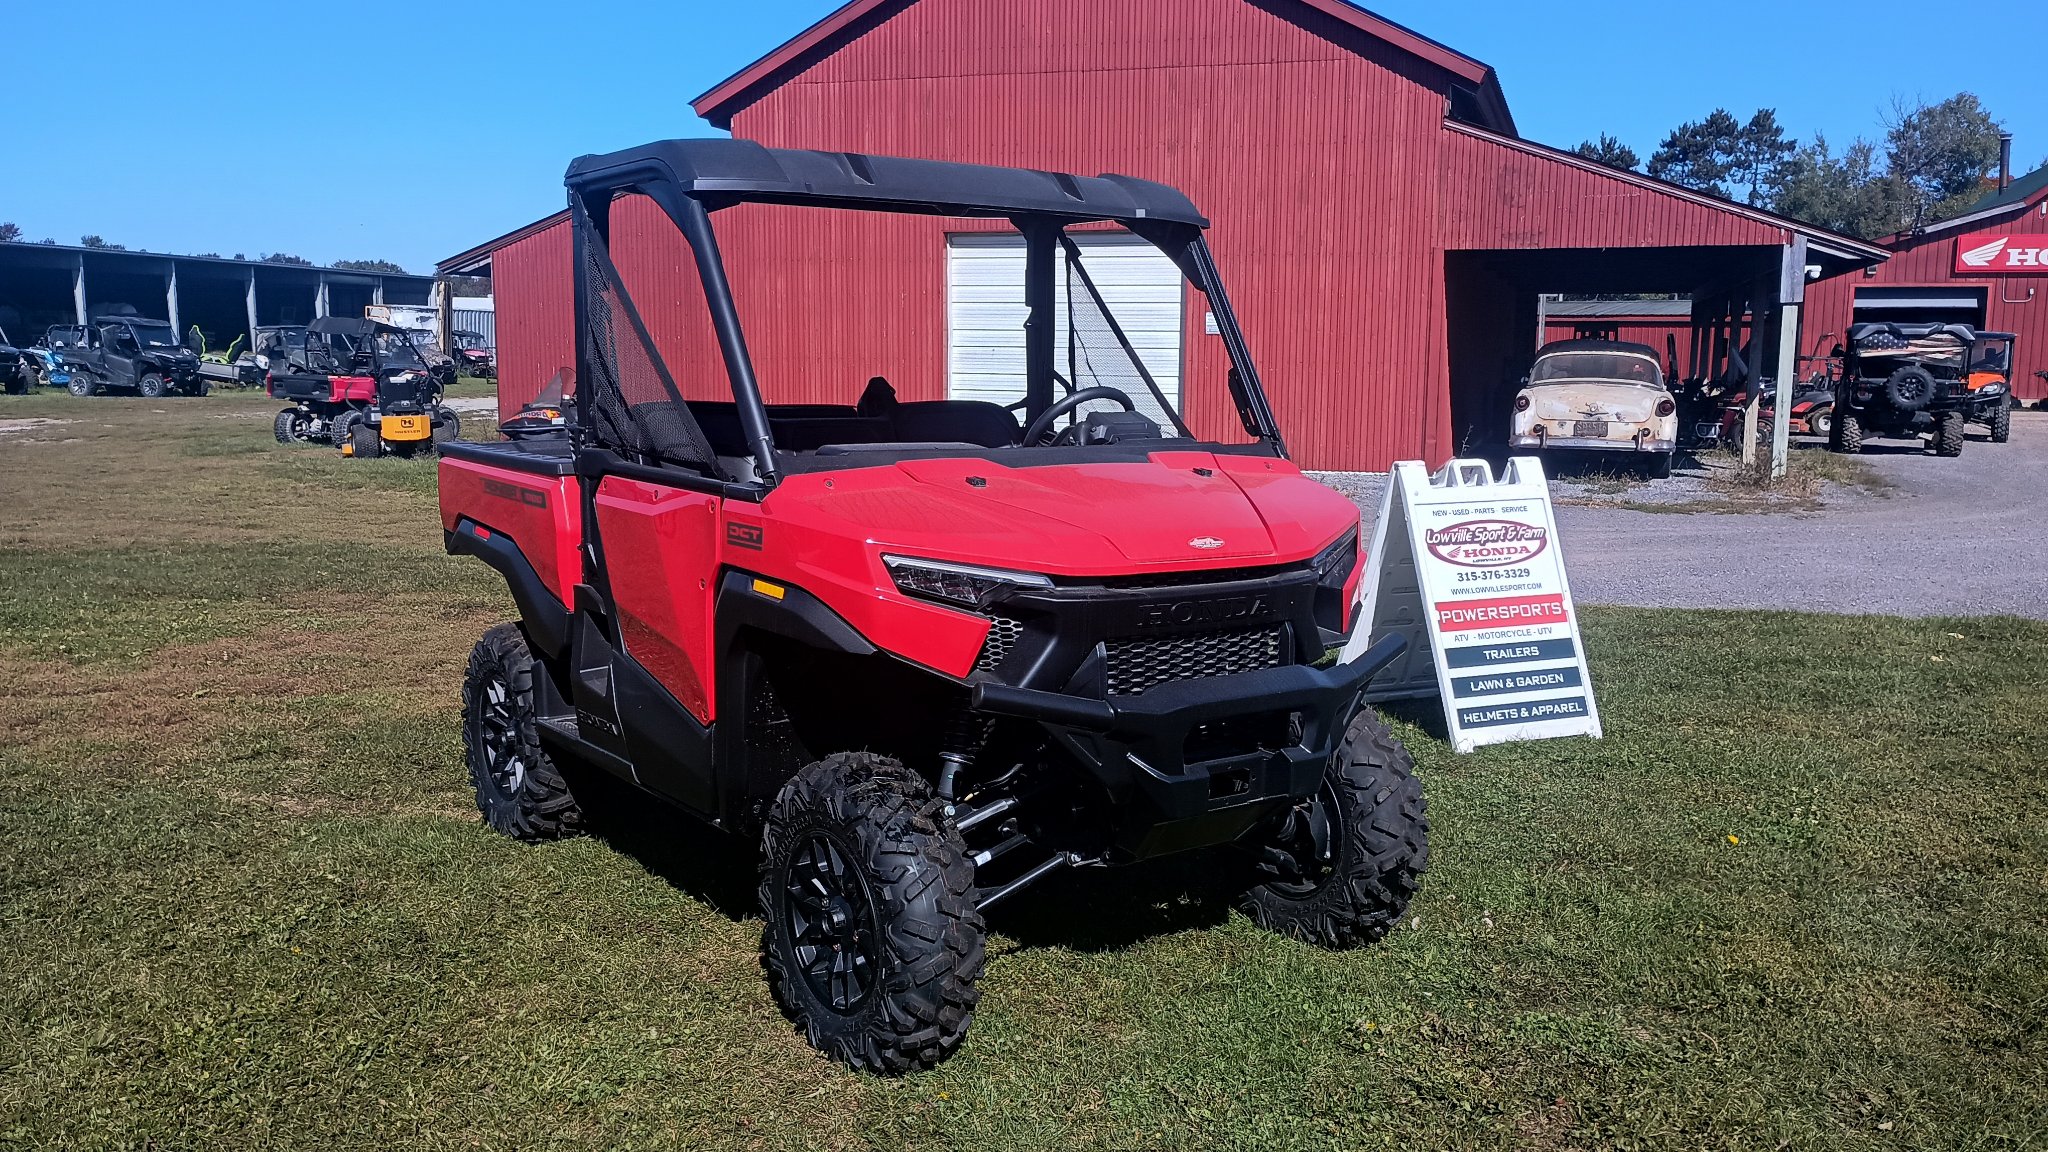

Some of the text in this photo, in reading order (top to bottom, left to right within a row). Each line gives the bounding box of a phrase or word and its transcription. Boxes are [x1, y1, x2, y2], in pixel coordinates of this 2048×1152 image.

[1432, 509, 1448, 517] NEW
[1452, 508, 1470, 516] USED
[1474, 507, 1496, 515] PARTS
[1501, 505, 1528, 513] SERVICE
[729, 526, 761, 540] DCT
[1426, 526, 1546, 545] Lowville Sport & Farm
[1463, 546, 1531, 558] HONDA
[1457, 568, 1530, 582] 315-376-3329
[1451, 582, 1543, 595] WWW.LOWVILLESPORT.COM
[1441, 601, 1562, 623] POWERSPORTS
[1454, 634, 1469, 642] ATV
[1478, 628, 1532, 640] MOTORCYCLE
[1537, 626, 1552, 635] UTV
[1483, 646, 1540, 660] TRAILERS
[1470, 673, 1564, 692] LAWN & GARDEN
[1463, 702, 1584, 723] HELMETS & APPAREL
